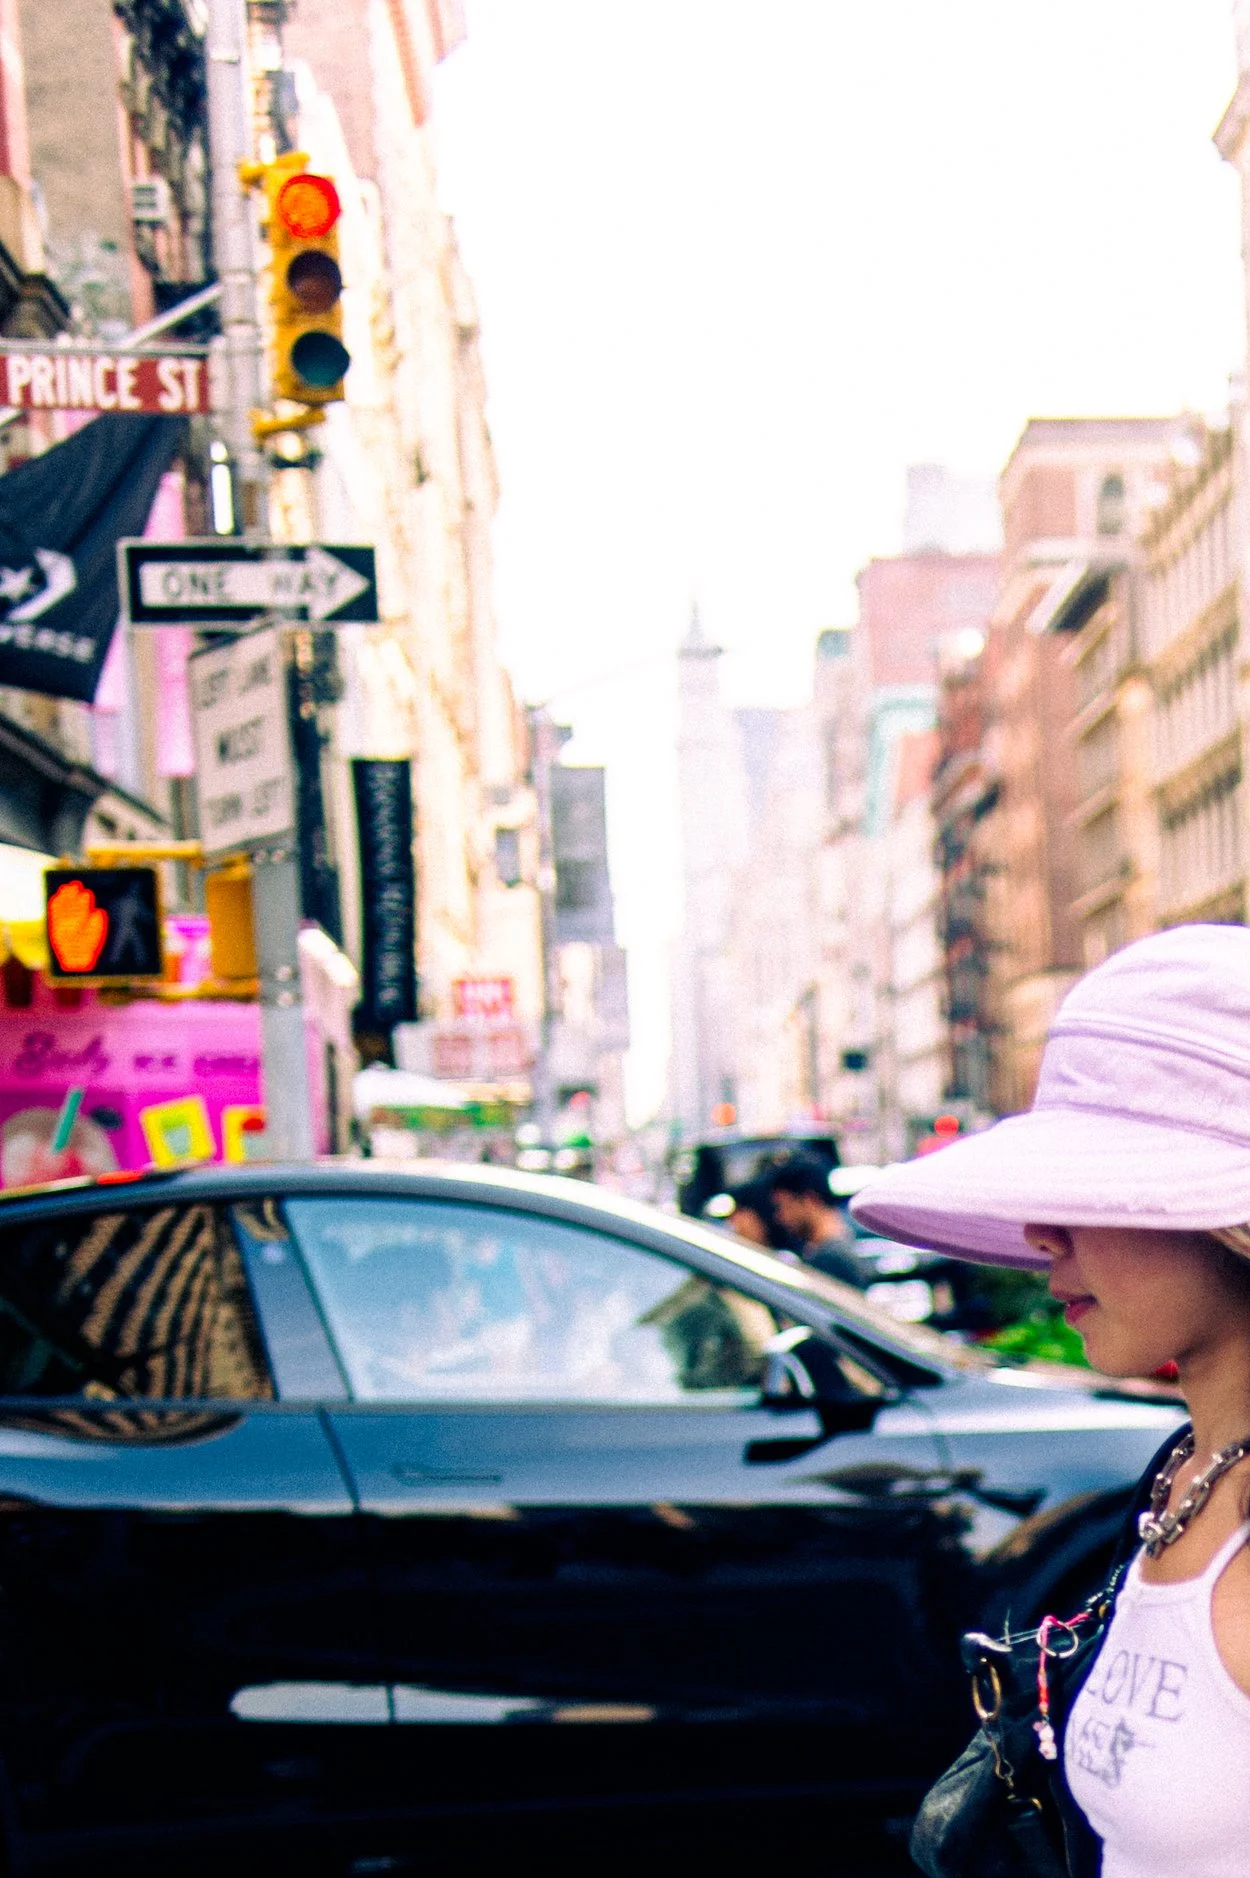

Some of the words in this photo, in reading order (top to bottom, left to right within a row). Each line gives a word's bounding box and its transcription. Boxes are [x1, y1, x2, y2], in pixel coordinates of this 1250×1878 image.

[7, 355, 143, 411] PRINCE
[156, 357, 202, 413] ST
[162, 568, 231, 601] ONE
[272, 569, 341, 600] WAY
